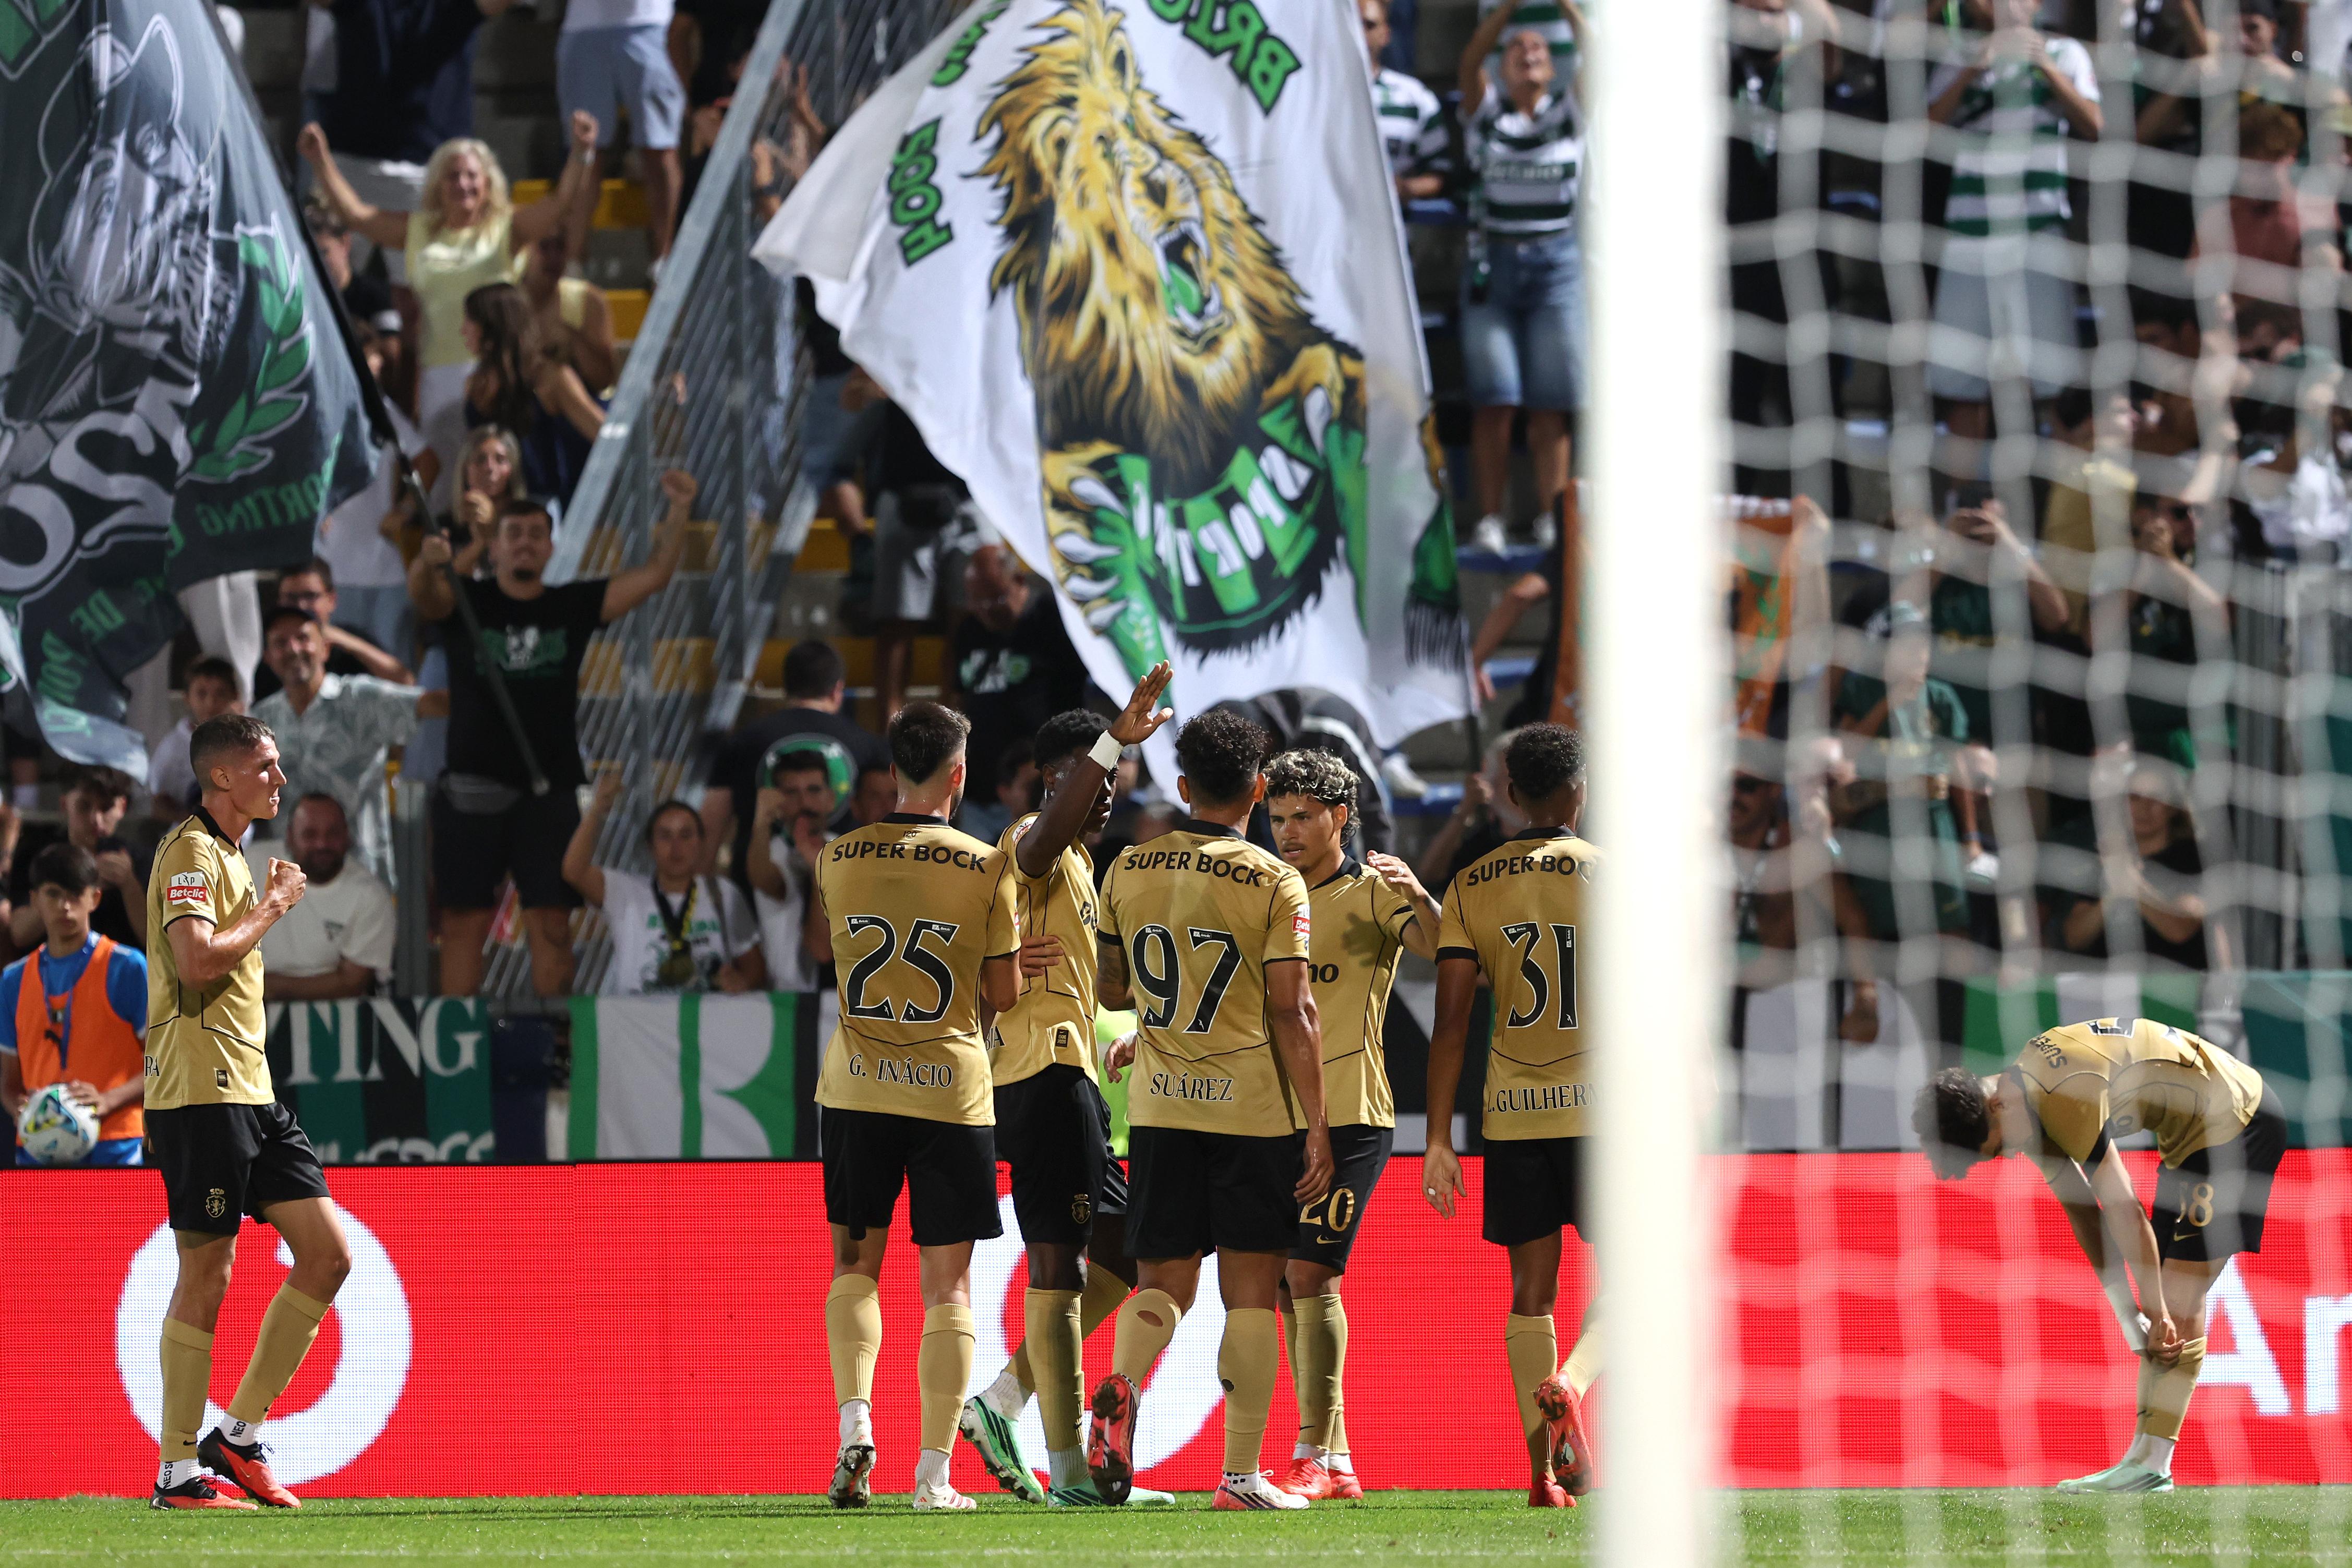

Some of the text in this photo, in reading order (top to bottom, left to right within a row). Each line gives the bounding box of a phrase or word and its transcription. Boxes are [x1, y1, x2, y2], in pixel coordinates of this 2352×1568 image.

[833, 841, 987, 874] SUPER BOCK
[1124, 851, 1264, 887] SUPER BOCK
[1467, 856, 1535, 886] SUPER
[170, 888, 204, 899] Betclic
[845, 914, 960, 1023] 25
[1132, 923, 1243, 1034] 97
[1500, 921, 1579, 1030] 31
[848, 1053, 953, 1088] G. INÁCIO
[1149, 1071, 1234, 1102] SUÁREZ
[1299, 1187, 1355, 1232] 20
[230, 1420, 247, 1438] NEO
[163, 1470, 172, 1490] NEO
